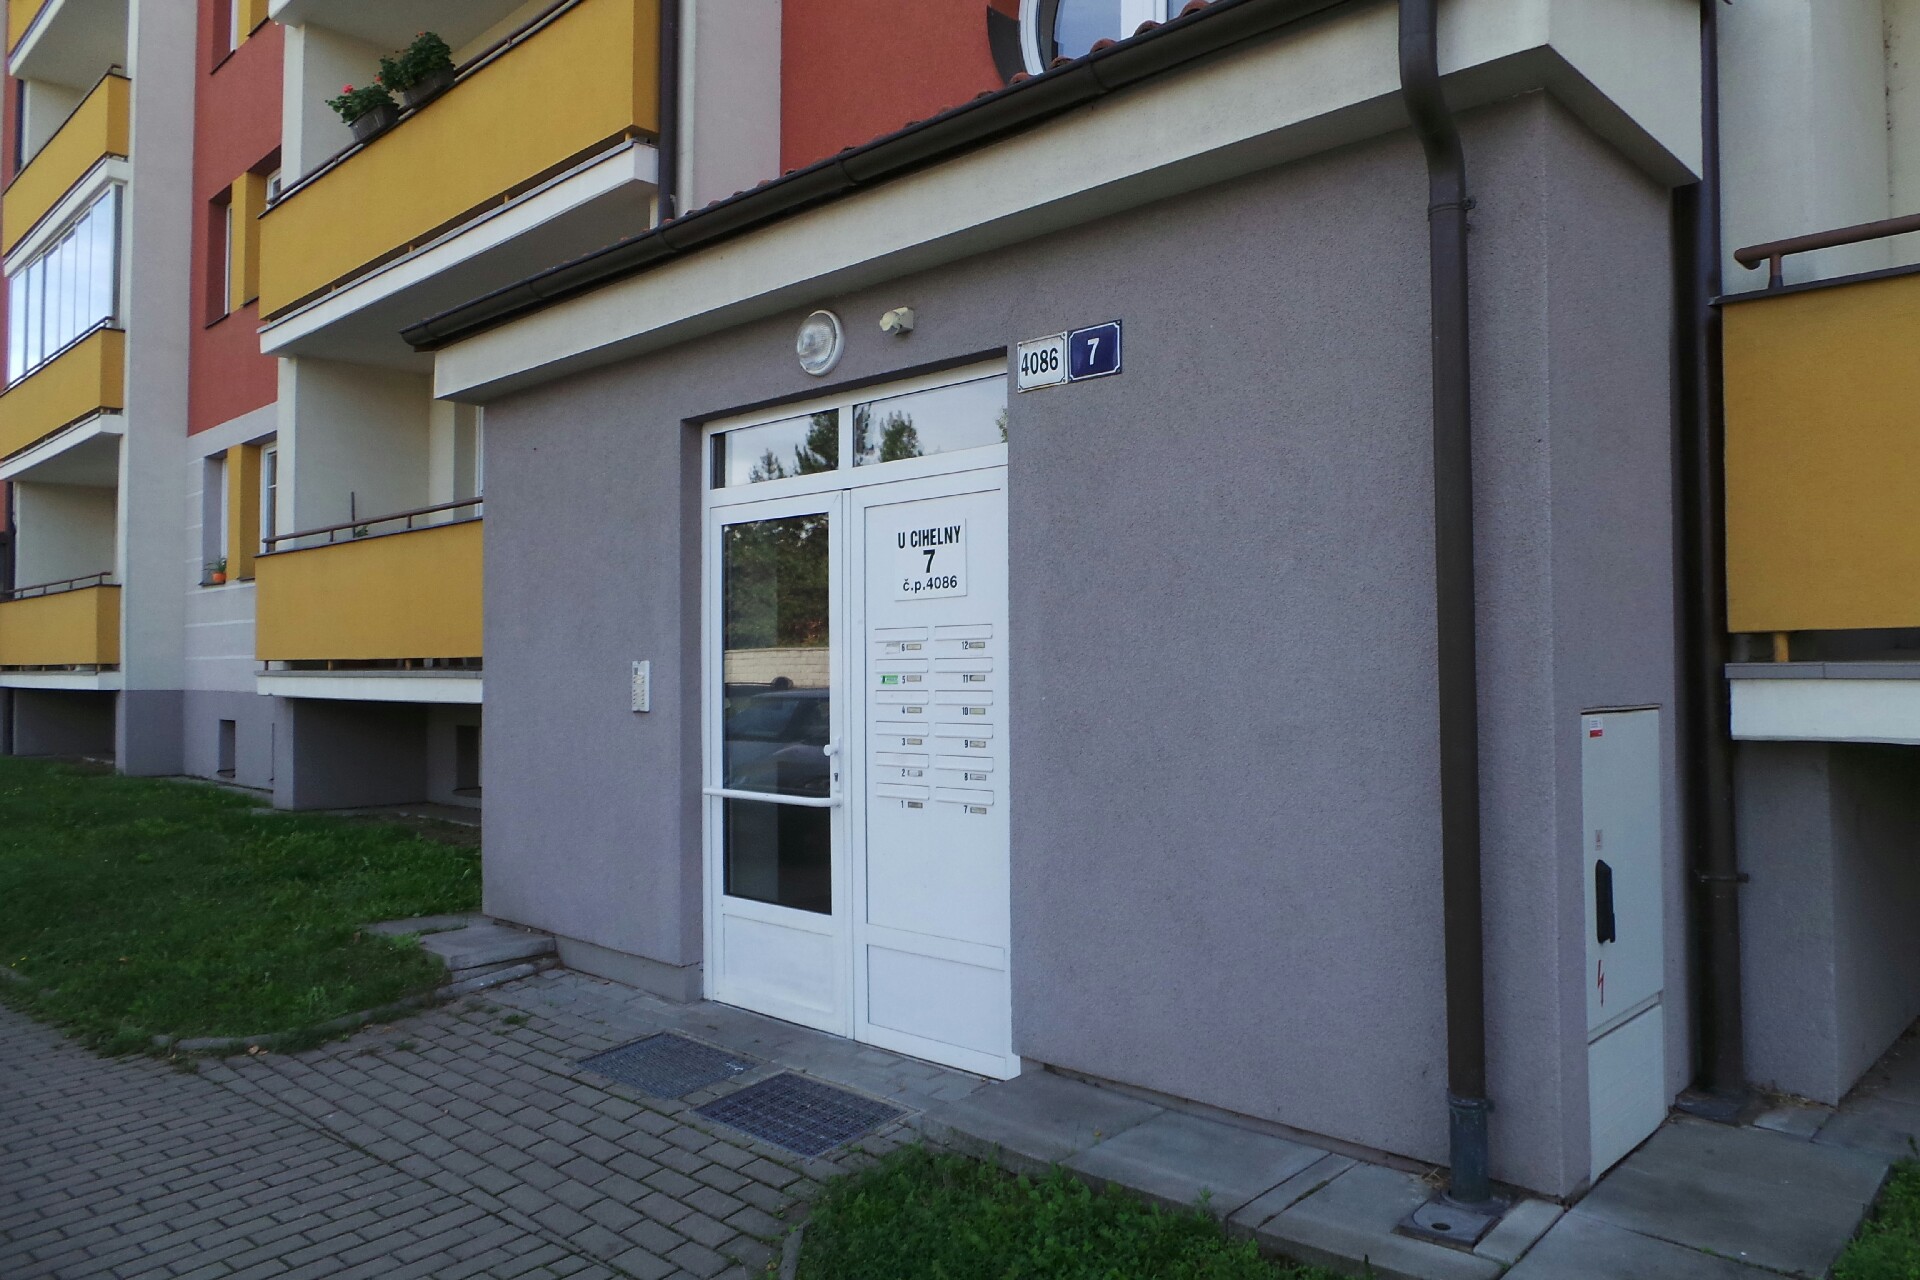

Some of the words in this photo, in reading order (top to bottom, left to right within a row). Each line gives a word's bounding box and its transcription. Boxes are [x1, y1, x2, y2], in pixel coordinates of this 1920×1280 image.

[1087, 337, 1100, 366] 7
[1021, 347, 1059, 377] 4086
[897, 531, 906, 549] U
[910, 524, 961, 548] CIHELNY
[922, 548, 936, 574] 7
[902, 574, 958, 594] č.p.4086
[901, 643, 906, 652] 6
[962, 641, 969, 650] 12
[901, 675, 906, 684] 5
[963, 674, 969, 683] 11
[962, 707, 969, 716] 10
[901, 738, 906, 746] 3
[901, 769, 906, 777] 2
[964, 773, 969, 781] 8
[963, 805, 968, 814] 7
